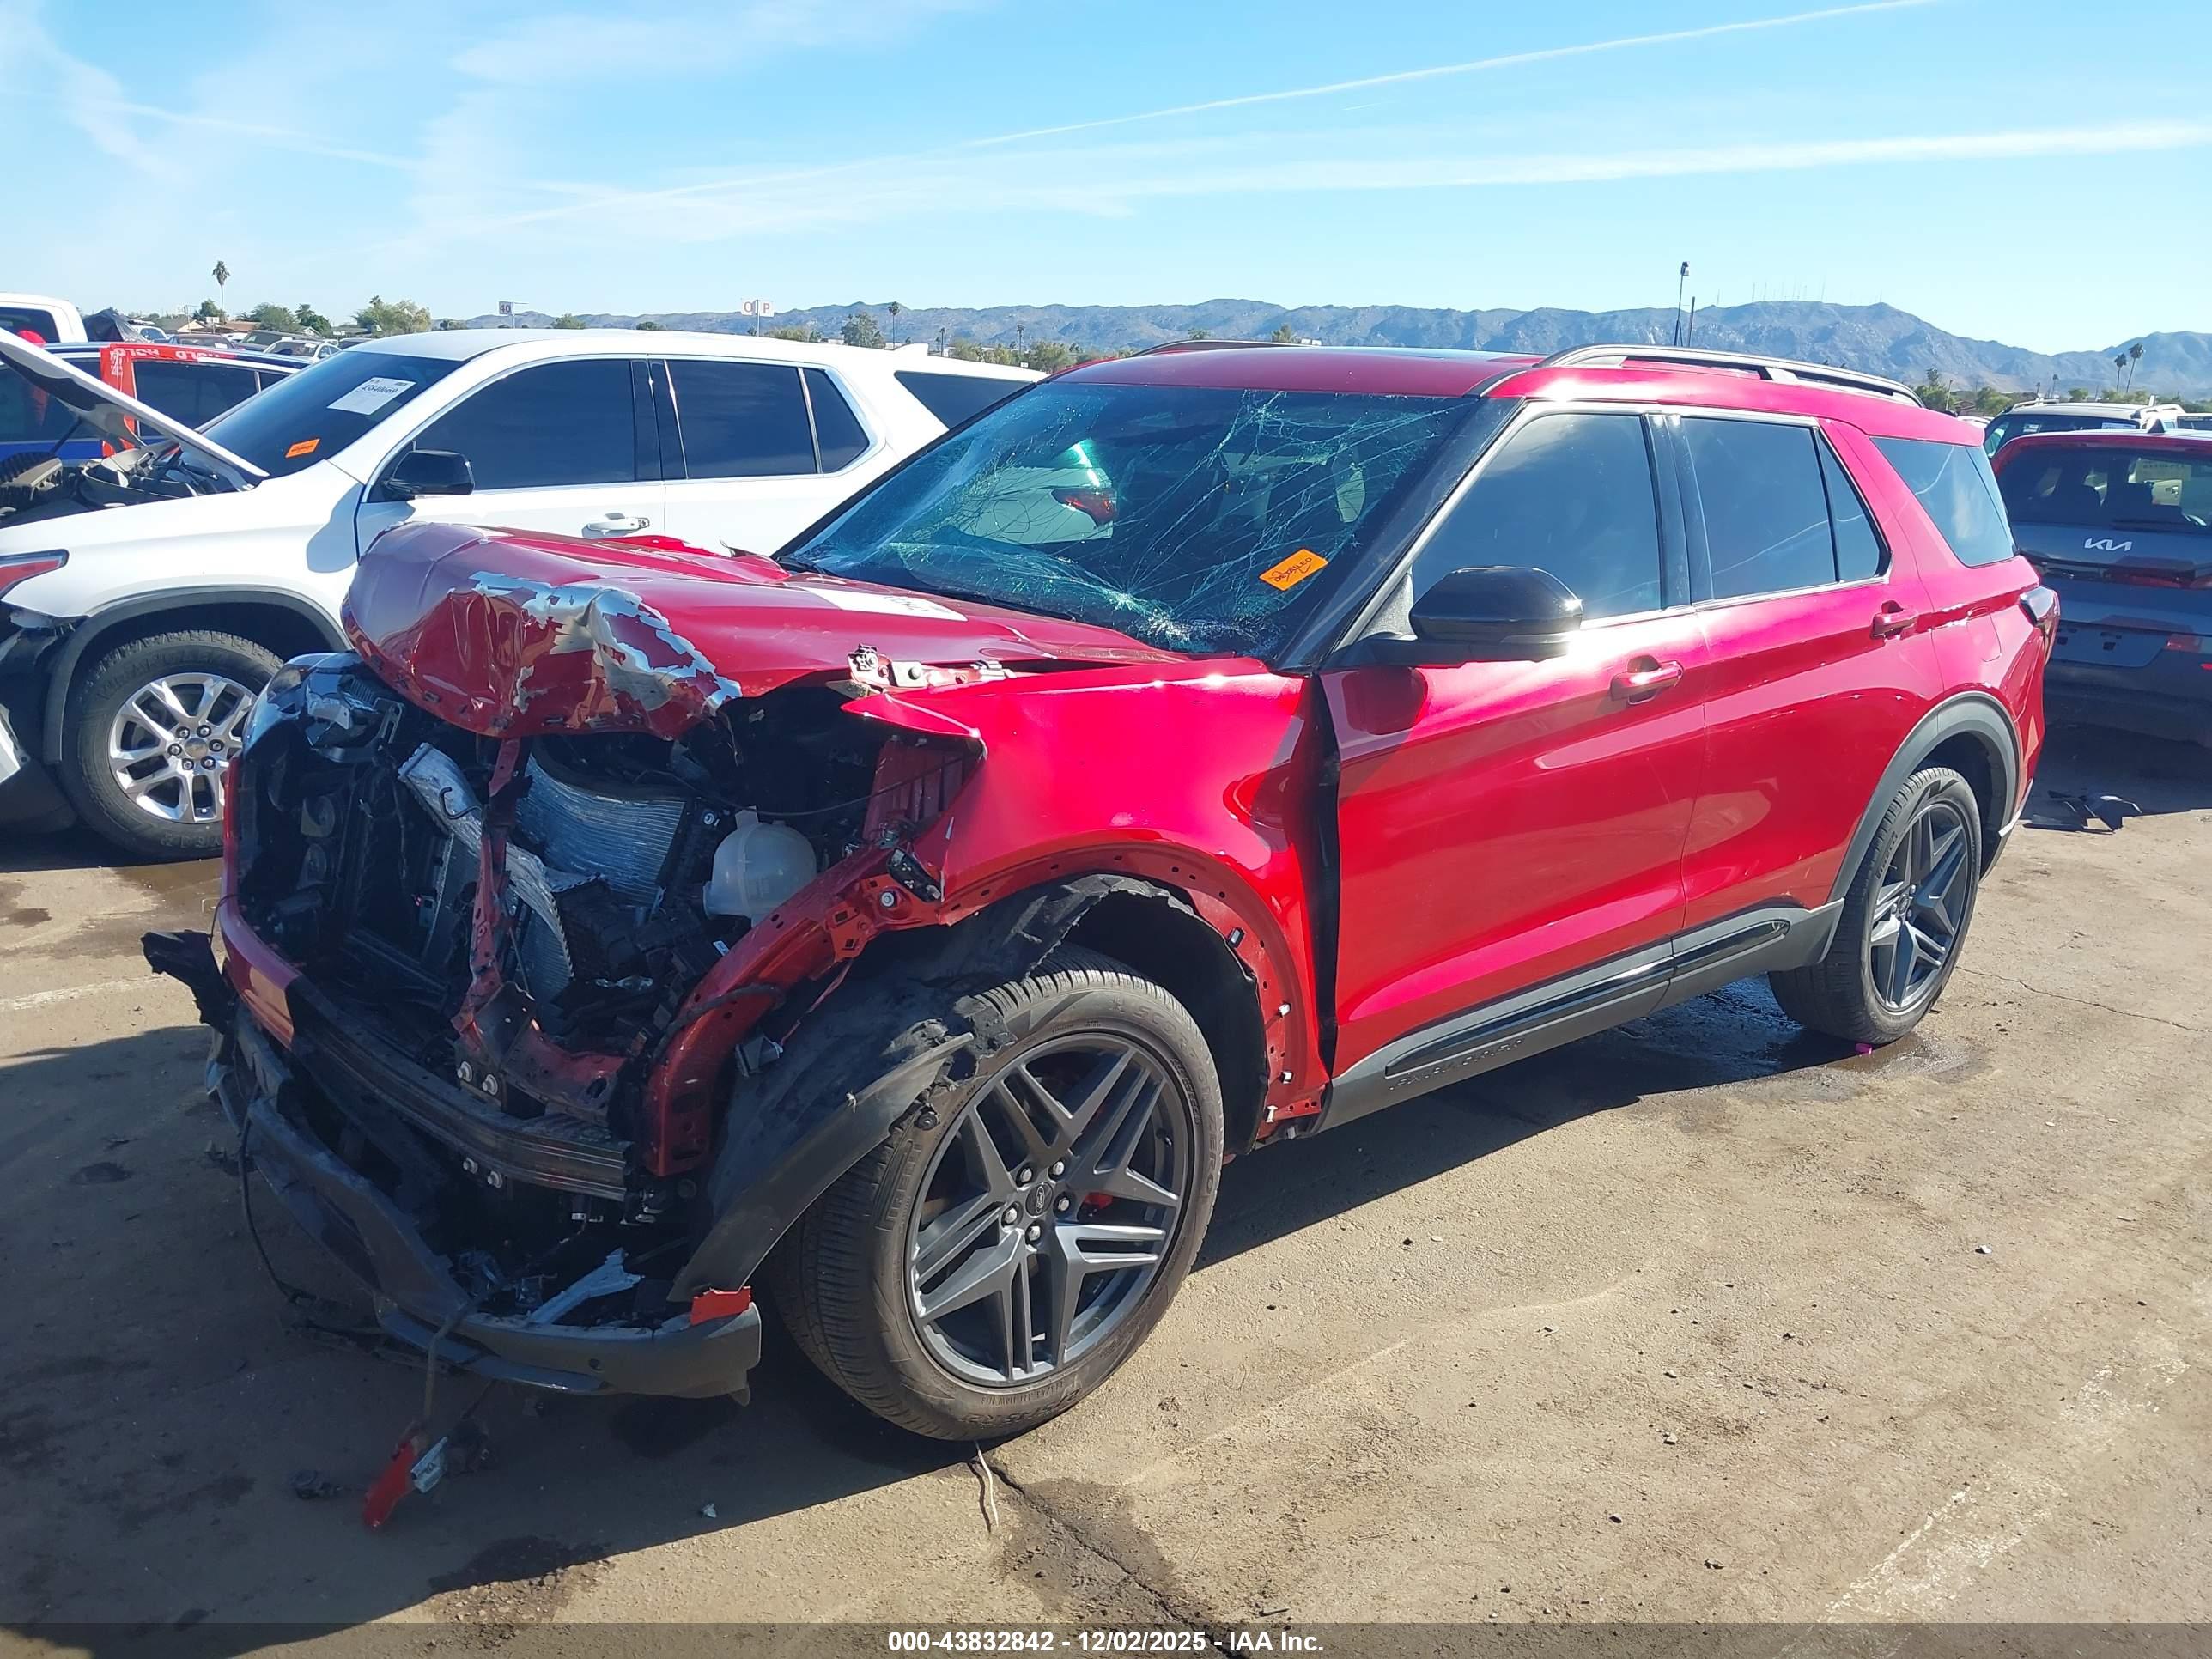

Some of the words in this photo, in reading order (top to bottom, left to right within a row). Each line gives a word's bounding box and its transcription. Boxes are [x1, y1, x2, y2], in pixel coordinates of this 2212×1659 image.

[500, 303, 511, 313] 40
[763, 302, 771, 314] P
[1206, 1114, 1218, 1194] ZERO
